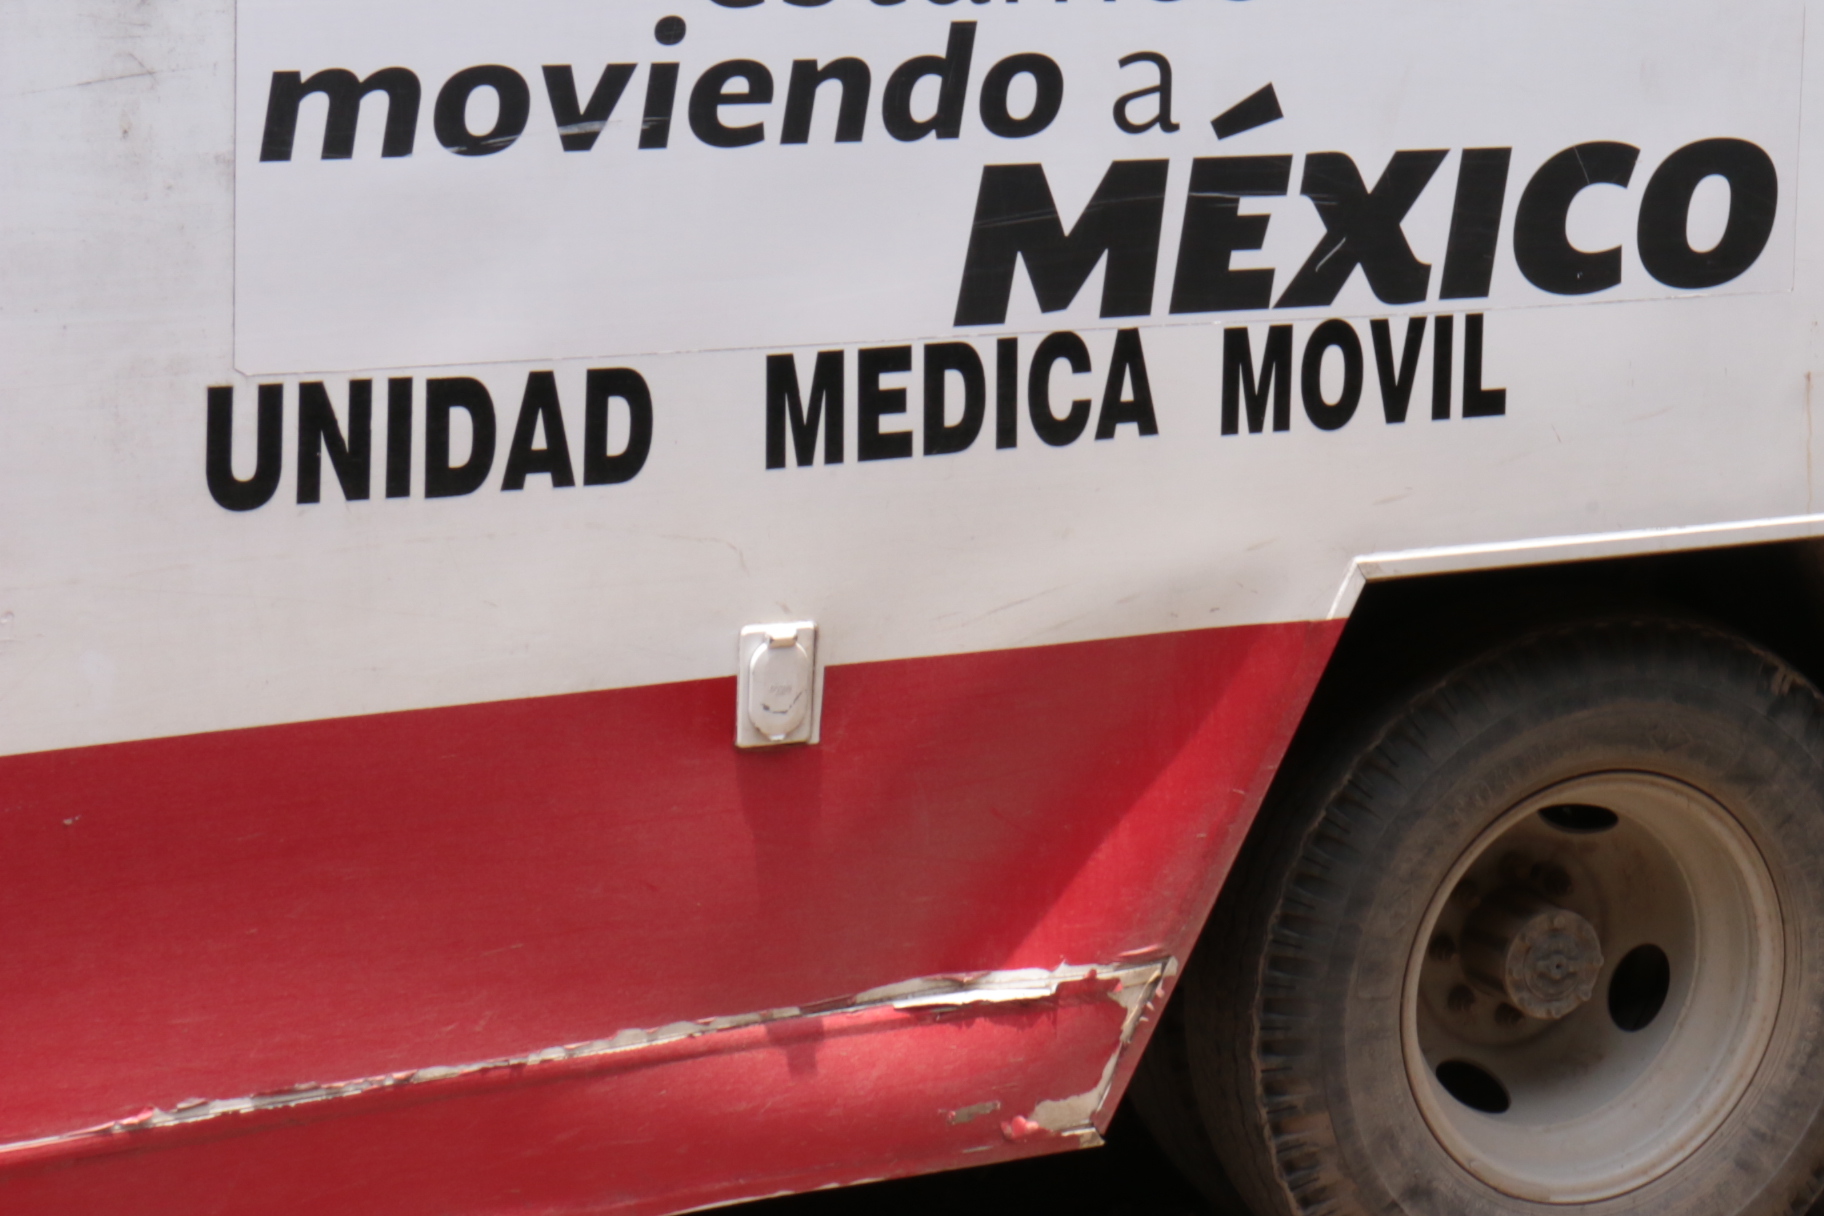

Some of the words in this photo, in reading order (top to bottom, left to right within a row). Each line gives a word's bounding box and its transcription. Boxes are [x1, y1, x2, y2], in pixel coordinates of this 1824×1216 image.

[259, 15, 1064, 162] moviendo
[1113, 51, 1180, 135] a
[953, 83, 1779, 327] MÉXICO
[205, 367, 653, 512] UNIDAD
[765, 327, 1159, 470] MEDICA
[1221, 313, 1508, 436] MOVIL
